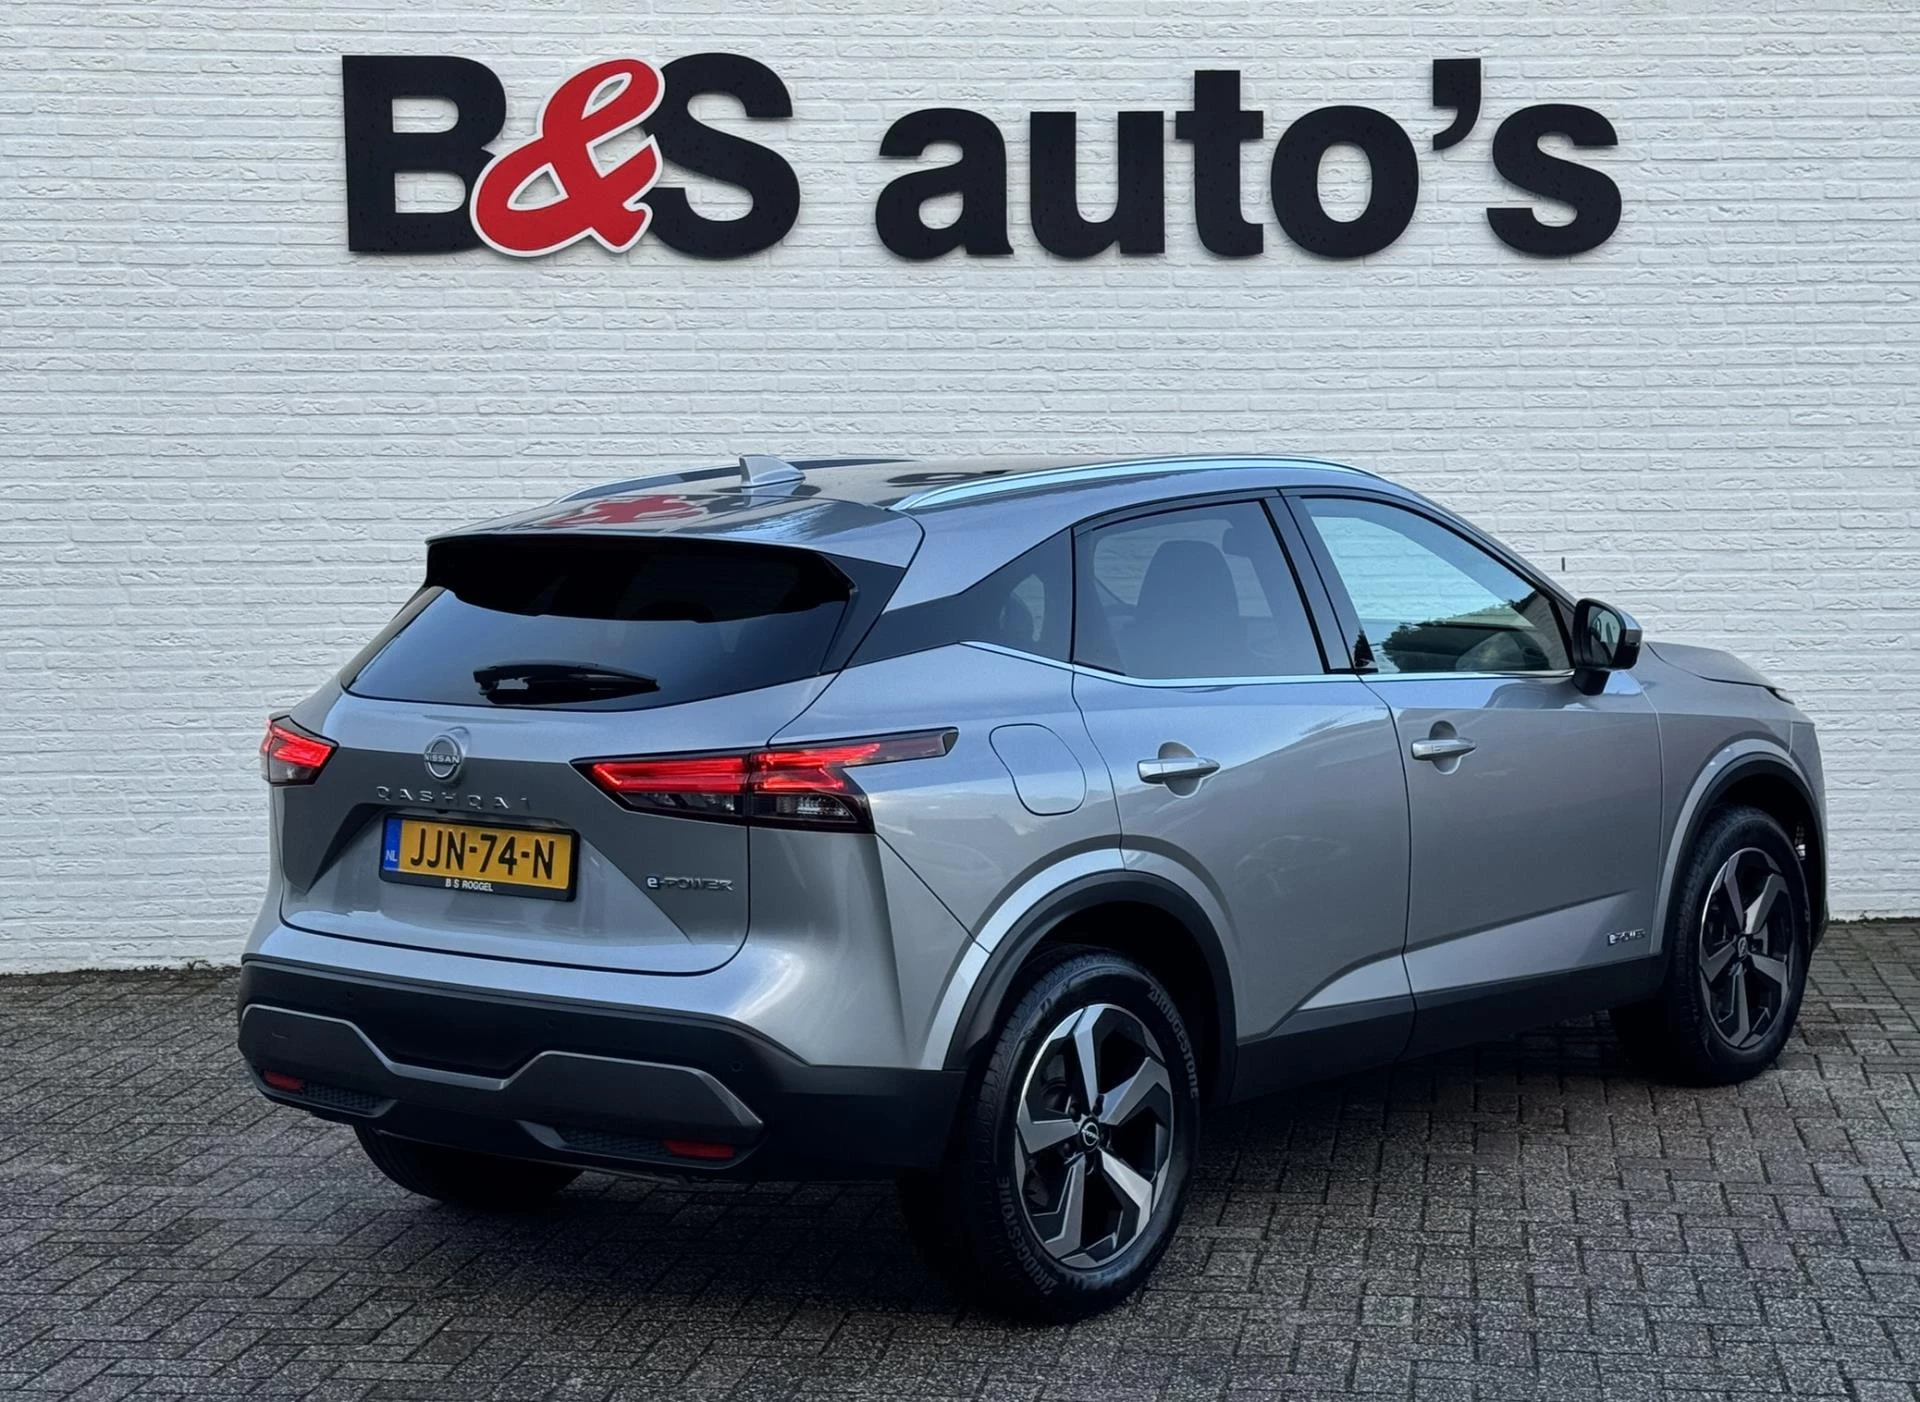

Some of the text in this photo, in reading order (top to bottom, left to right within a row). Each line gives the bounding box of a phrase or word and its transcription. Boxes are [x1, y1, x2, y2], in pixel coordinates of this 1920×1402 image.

[342, 52, 1622, 261] B&S auto's
[425, 753, 460, 764] NISSAN
[376, 785, 530, 810] QASHQAI
[385, 850, 398, 862] NL
[410, 827, 555, 880] JJN-74-N
[462, 880, 493, 892] ROGGEL
